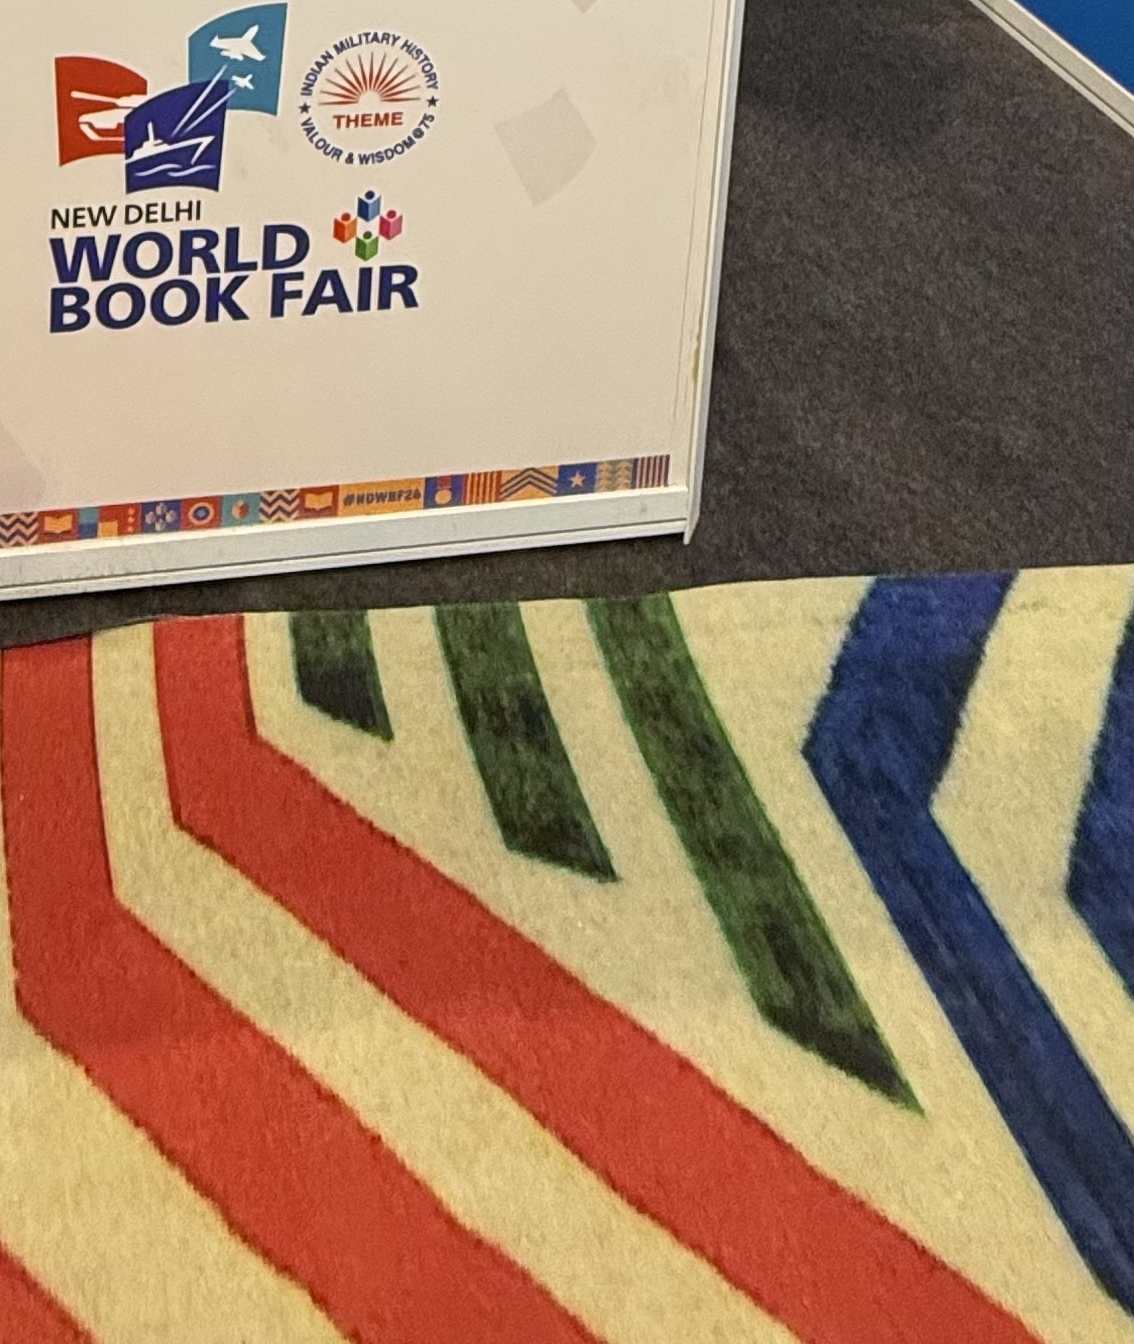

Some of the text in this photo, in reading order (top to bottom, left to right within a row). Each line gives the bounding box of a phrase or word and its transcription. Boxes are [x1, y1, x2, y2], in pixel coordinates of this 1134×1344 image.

[300, 31, 439, 96] INDIAN MILITARY HISTORY
[300, 116, 344, 163] VALOUR
[344, 152, 354, 165] &
[332, 111, 404, 130] THEME
[50, 200, 202, 229] NEW DELHI
[49, 223, 311, 284] WORLD
[50, 264, 419, 334] BOOK FAIR
